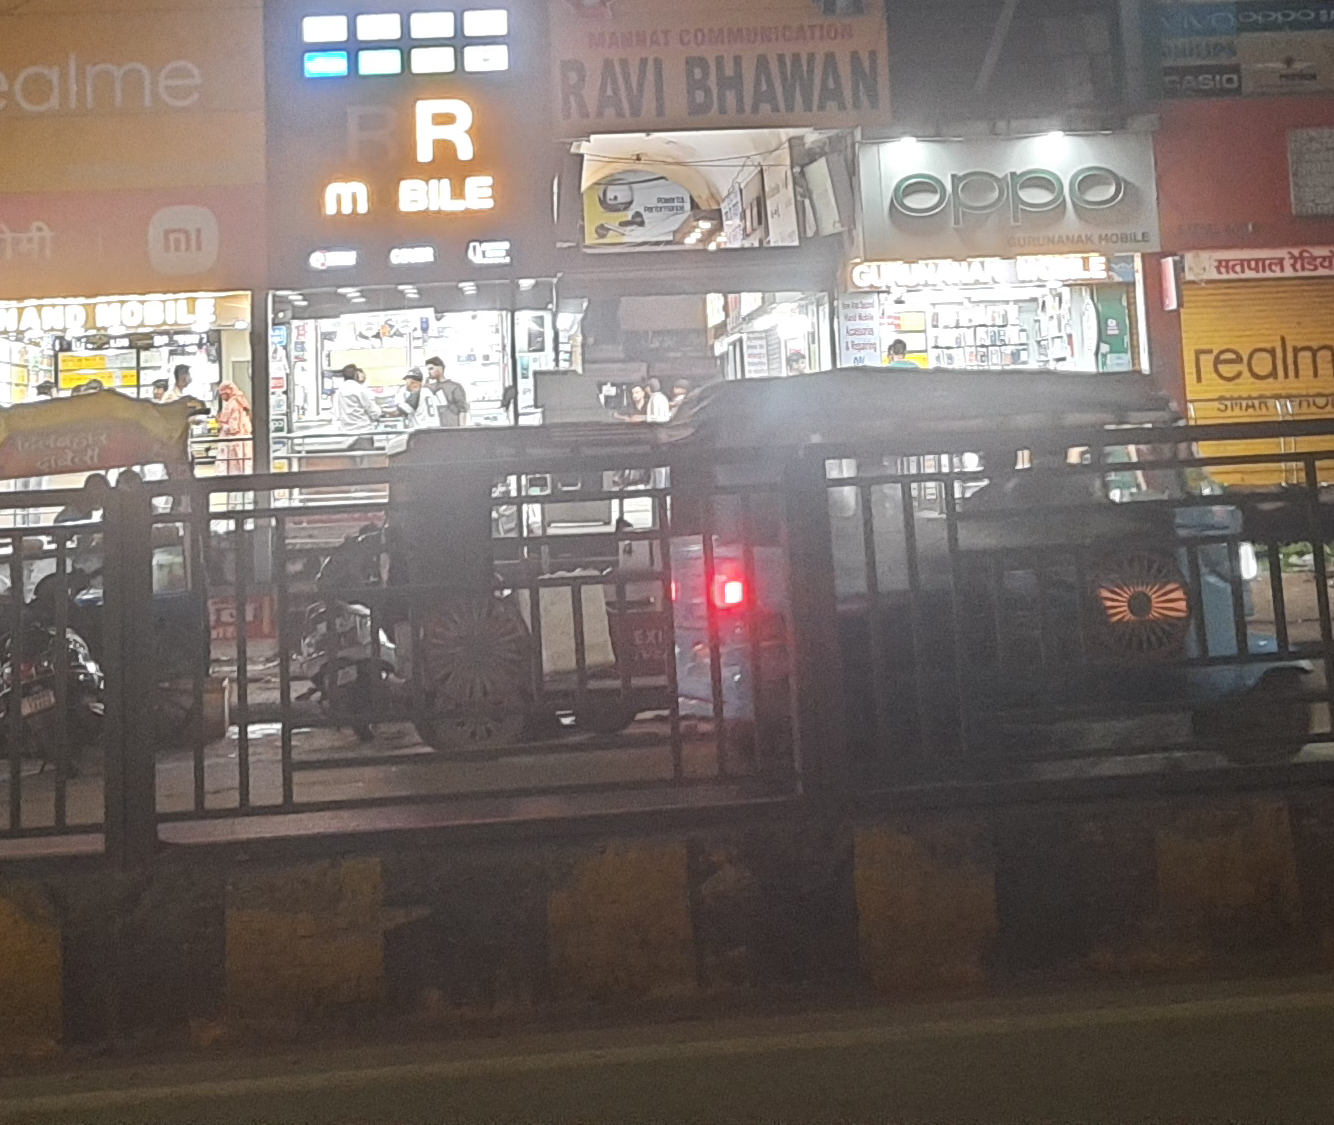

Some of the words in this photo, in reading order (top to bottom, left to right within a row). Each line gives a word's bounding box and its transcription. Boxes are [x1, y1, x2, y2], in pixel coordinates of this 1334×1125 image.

[1238, 9, 1316, 25] oppo
[587, 29, 671, 49] MANNAT
[678, 22, 855, 47] COMMUNICATION
[560, 56, 667, 121] RAVI
[683, 48, 881, 118] BHAWAN
[1163, 73, 1238, 91] CASIO
[893, 165, 1125, 226] oppo
[1007, 232, 1095, 249] GURUNANAK
[1097, 230, 1152, 246] MOBILE
[1213, 255, 1285, 276] सतपाल
[94, 297, 217, 328] MOBILE
